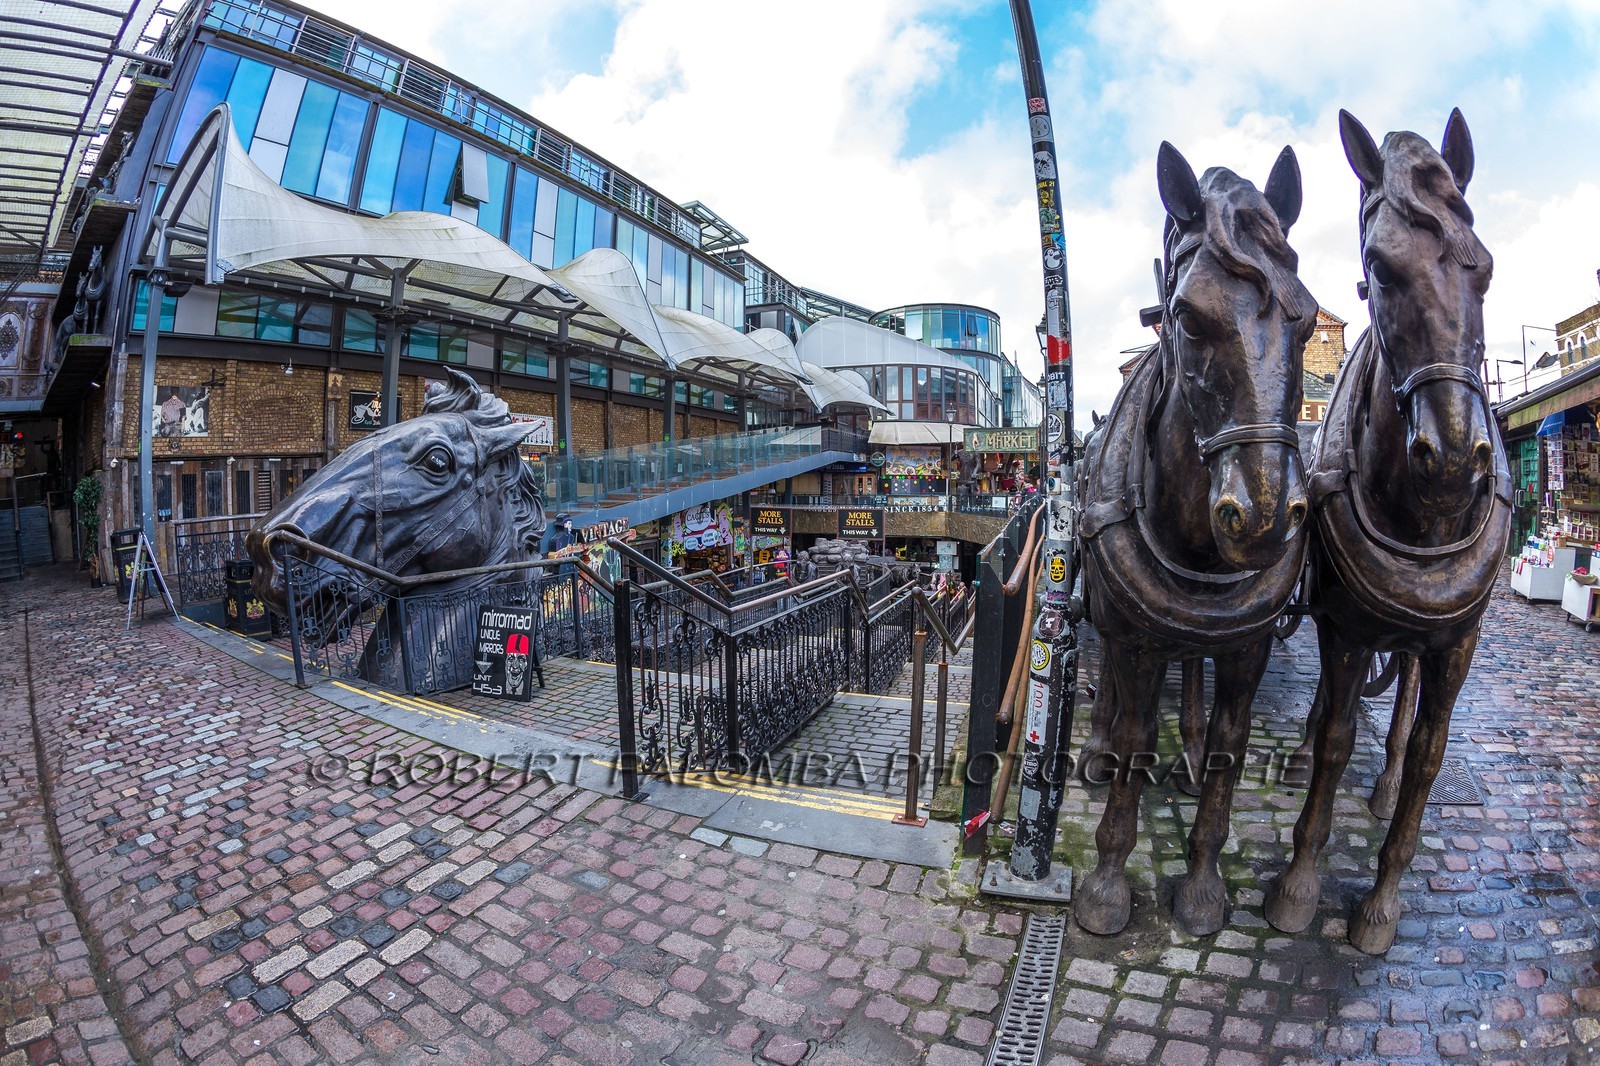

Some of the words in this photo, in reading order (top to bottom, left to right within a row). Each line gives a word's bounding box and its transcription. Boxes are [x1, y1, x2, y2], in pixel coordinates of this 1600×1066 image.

[985, 433, 1035, 450] MARKET
[759, 510, 782, 518] MORE
[848, 511, 873, 520] MORE
[757, 517, 784, 525] STALLS
[845, 519, 875, 527] STALLS
[581, 519, 630, 543] VINTAGE
[481, 609, 533, 631] mirrormad
[478, 642, 504, 655] MIRRORS
[473, 673, 493, 682] UNIT
[472, 682, 503, 695] 453
